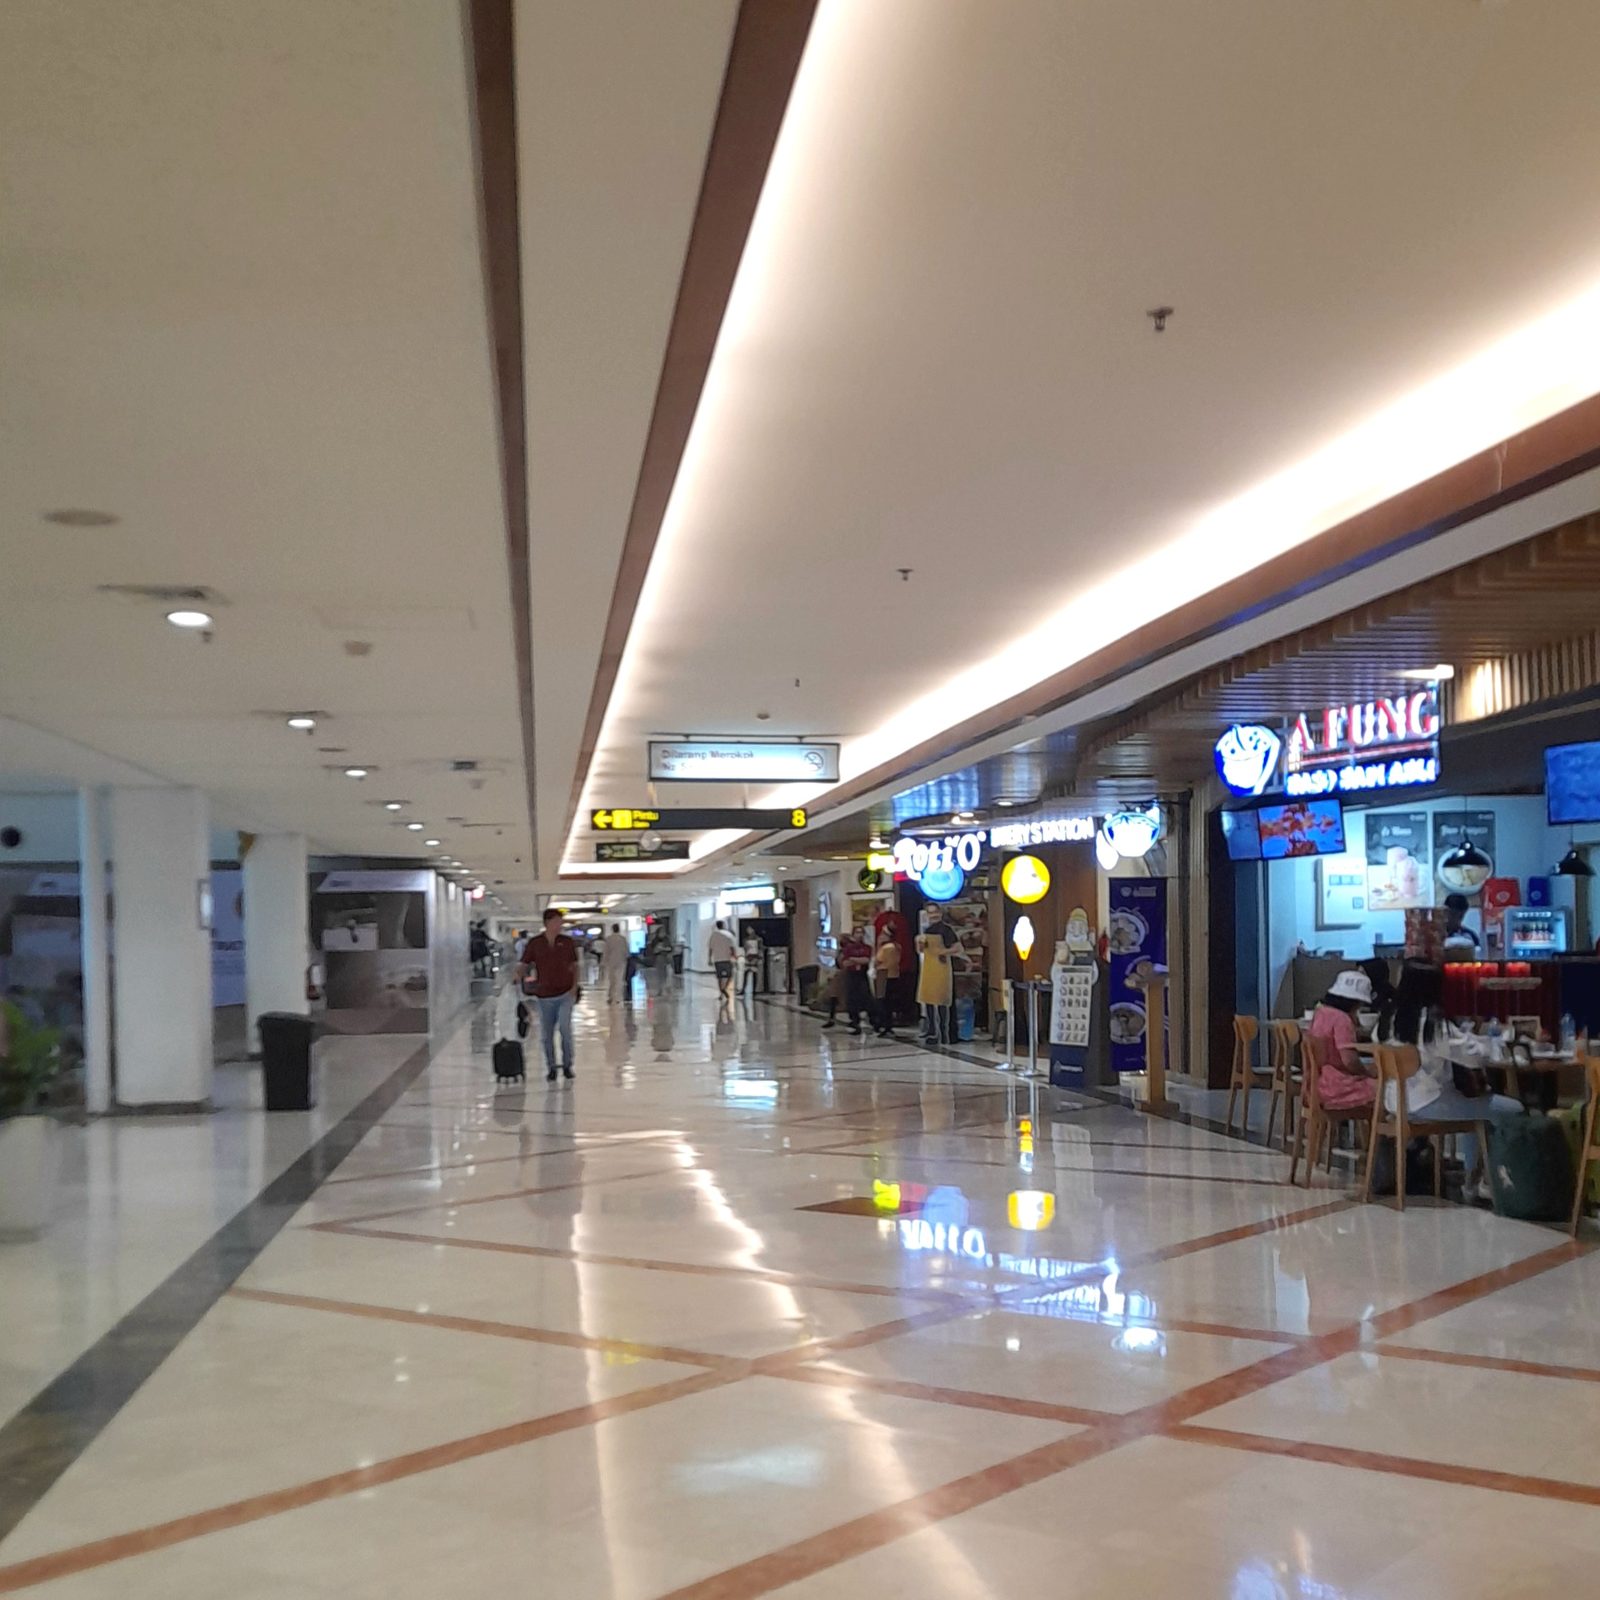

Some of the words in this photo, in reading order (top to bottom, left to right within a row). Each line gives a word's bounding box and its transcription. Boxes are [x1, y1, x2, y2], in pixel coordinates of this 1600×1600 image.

[1289, 711, 1316, 752] A
[1323, 691, 1440, 750] FUNG
[791, 809, 806, 827] 8
[990, 823, 1031, 847] ERY
[1030, 816, 1095, 843] STATION
